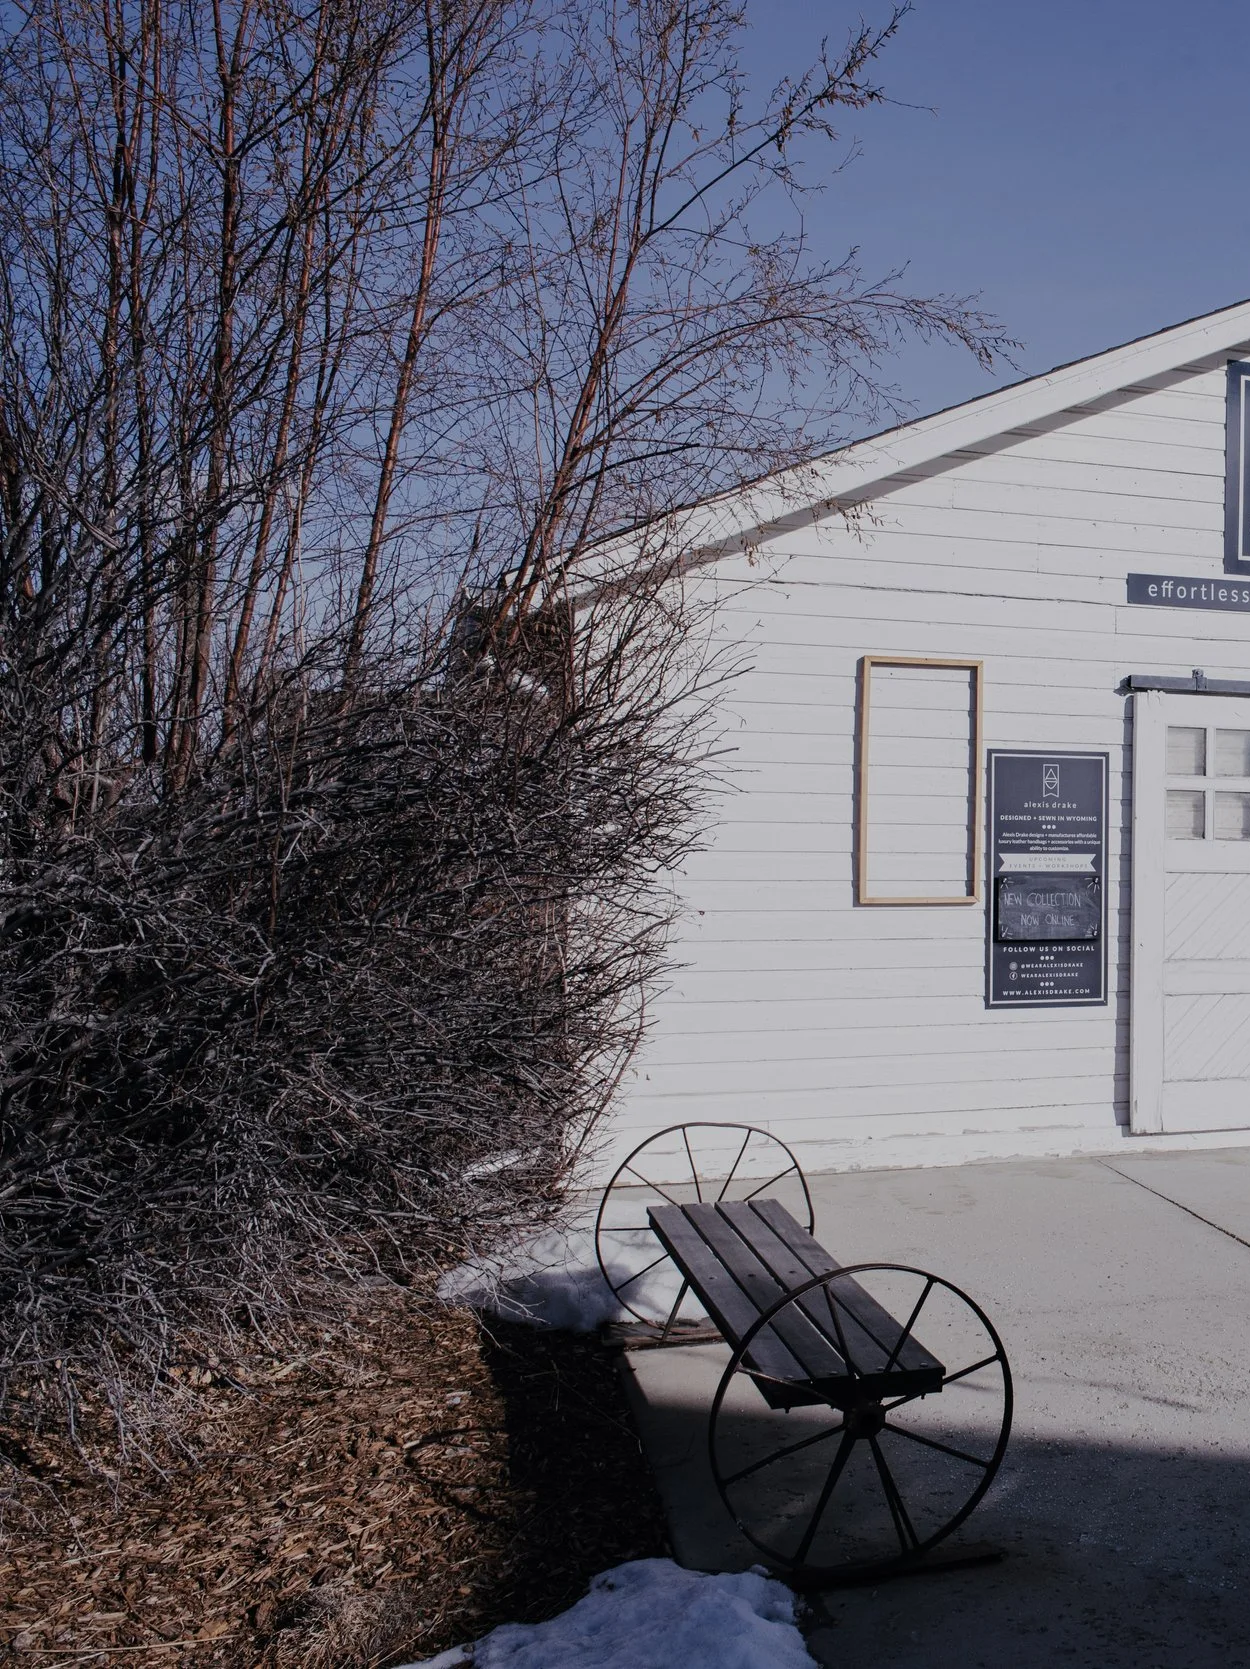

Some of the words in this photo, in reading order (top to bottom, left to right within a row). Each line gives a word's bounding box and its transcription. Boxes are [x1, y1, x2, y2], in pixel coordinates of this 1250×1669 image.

[1148, 581, 1250, 603] effortless
[1004, 893, 1022, 906] NEW
[1027, 892, 1081, 907] COLLECTION
[1021, 914, 1039, 926] NOW
[1045, 913, 1075, 926] ONLINE
